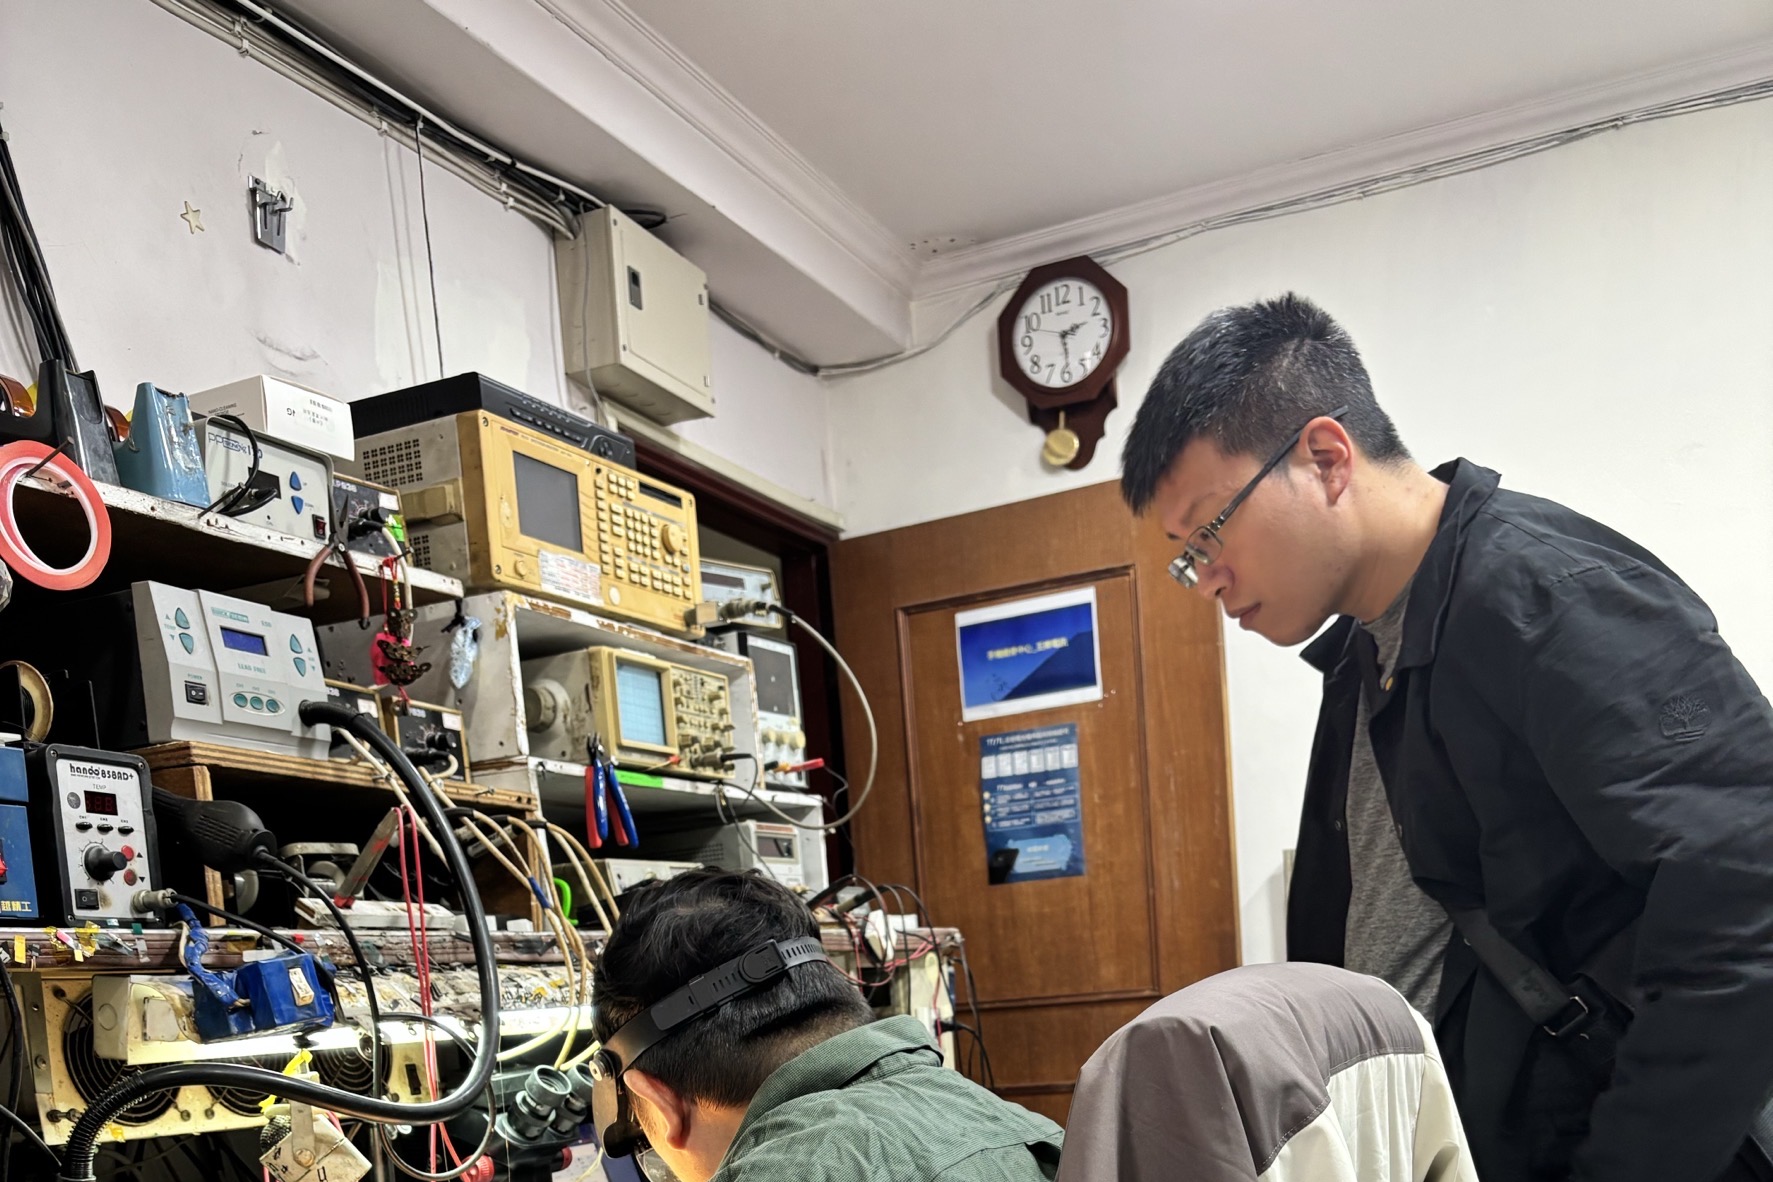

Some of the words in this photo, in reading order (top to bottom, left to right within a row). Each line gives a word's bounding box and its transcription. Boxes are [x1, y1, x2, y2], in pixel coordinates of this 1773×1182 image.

[1040, 293, 1053, 314] 11
[1054, 284, 1071, 306] 12
[1077, 286, 1085, 307] 1
[1089, 296, 1101, 317] 2
[1023, 313, 1041, 333] 10
[1099, 318, 1109, 338] 3
[1020, 335, 1034, 355] 9
[1092, 341, 1101, 360] 4
[1029, 354, 1042, 375] 8
[1045, 363, 1056, 384] 7
[1060, 364, 1074, 384] 6
[1078, 358, 1088, 378] 5
[92, 783, 107, 791] TEMP
